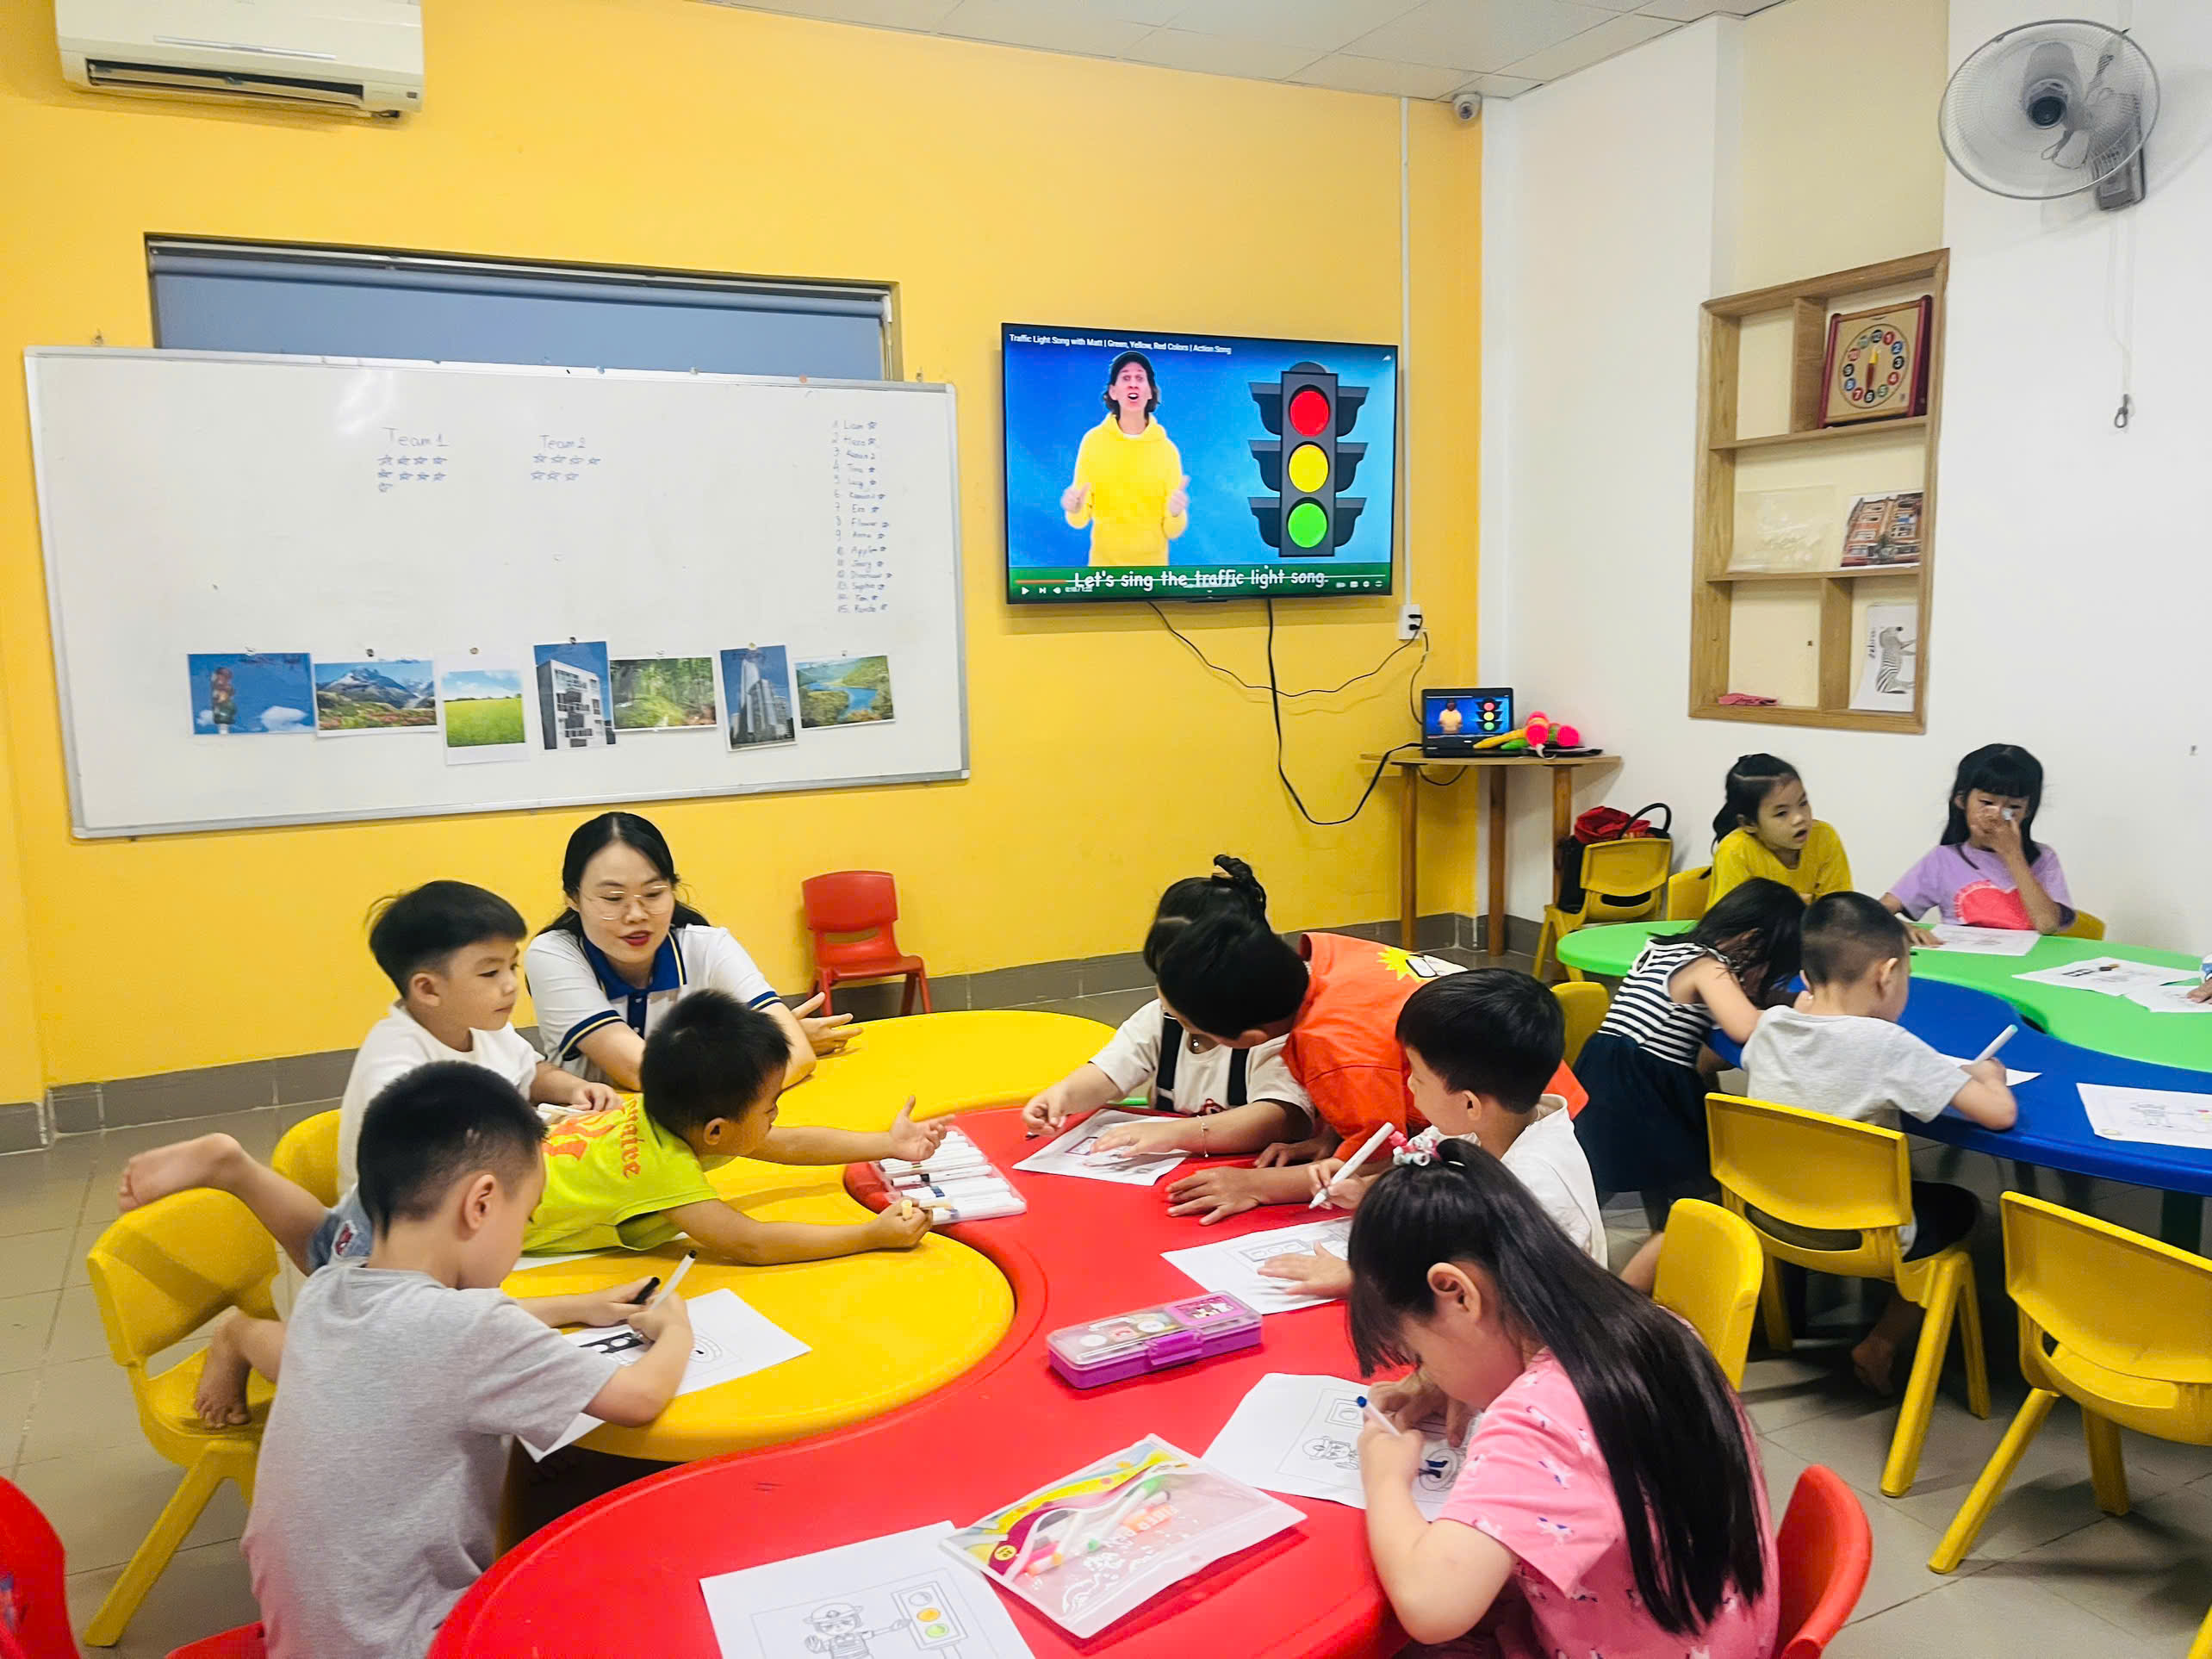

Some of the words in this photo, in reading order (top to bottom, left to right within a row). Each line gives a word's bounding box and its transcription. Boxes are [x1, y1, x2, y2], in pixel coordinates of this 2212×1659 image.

[1009, 333, 1032, 342] Traffic
[1033, 335, 1051, 345] Light
[1052, 336, 1070, 346] Song
[1214, 345, 1232, 355] Song
[379, 426, 431, 447] Team
[434, 433, 450, 447] 1
[537, 434, 575, 449] Team
[577, 437, 587, 449] 2
[1074, 570, 1115, 587] Let's
[1121, 571, 1153, 591] sing
[1160, 570, 1188, 587] the
[1194, 569, 1245, 587] traffic
[1251, 565, 1285, 589] light
[1291, 571, 1329, 588] song.
